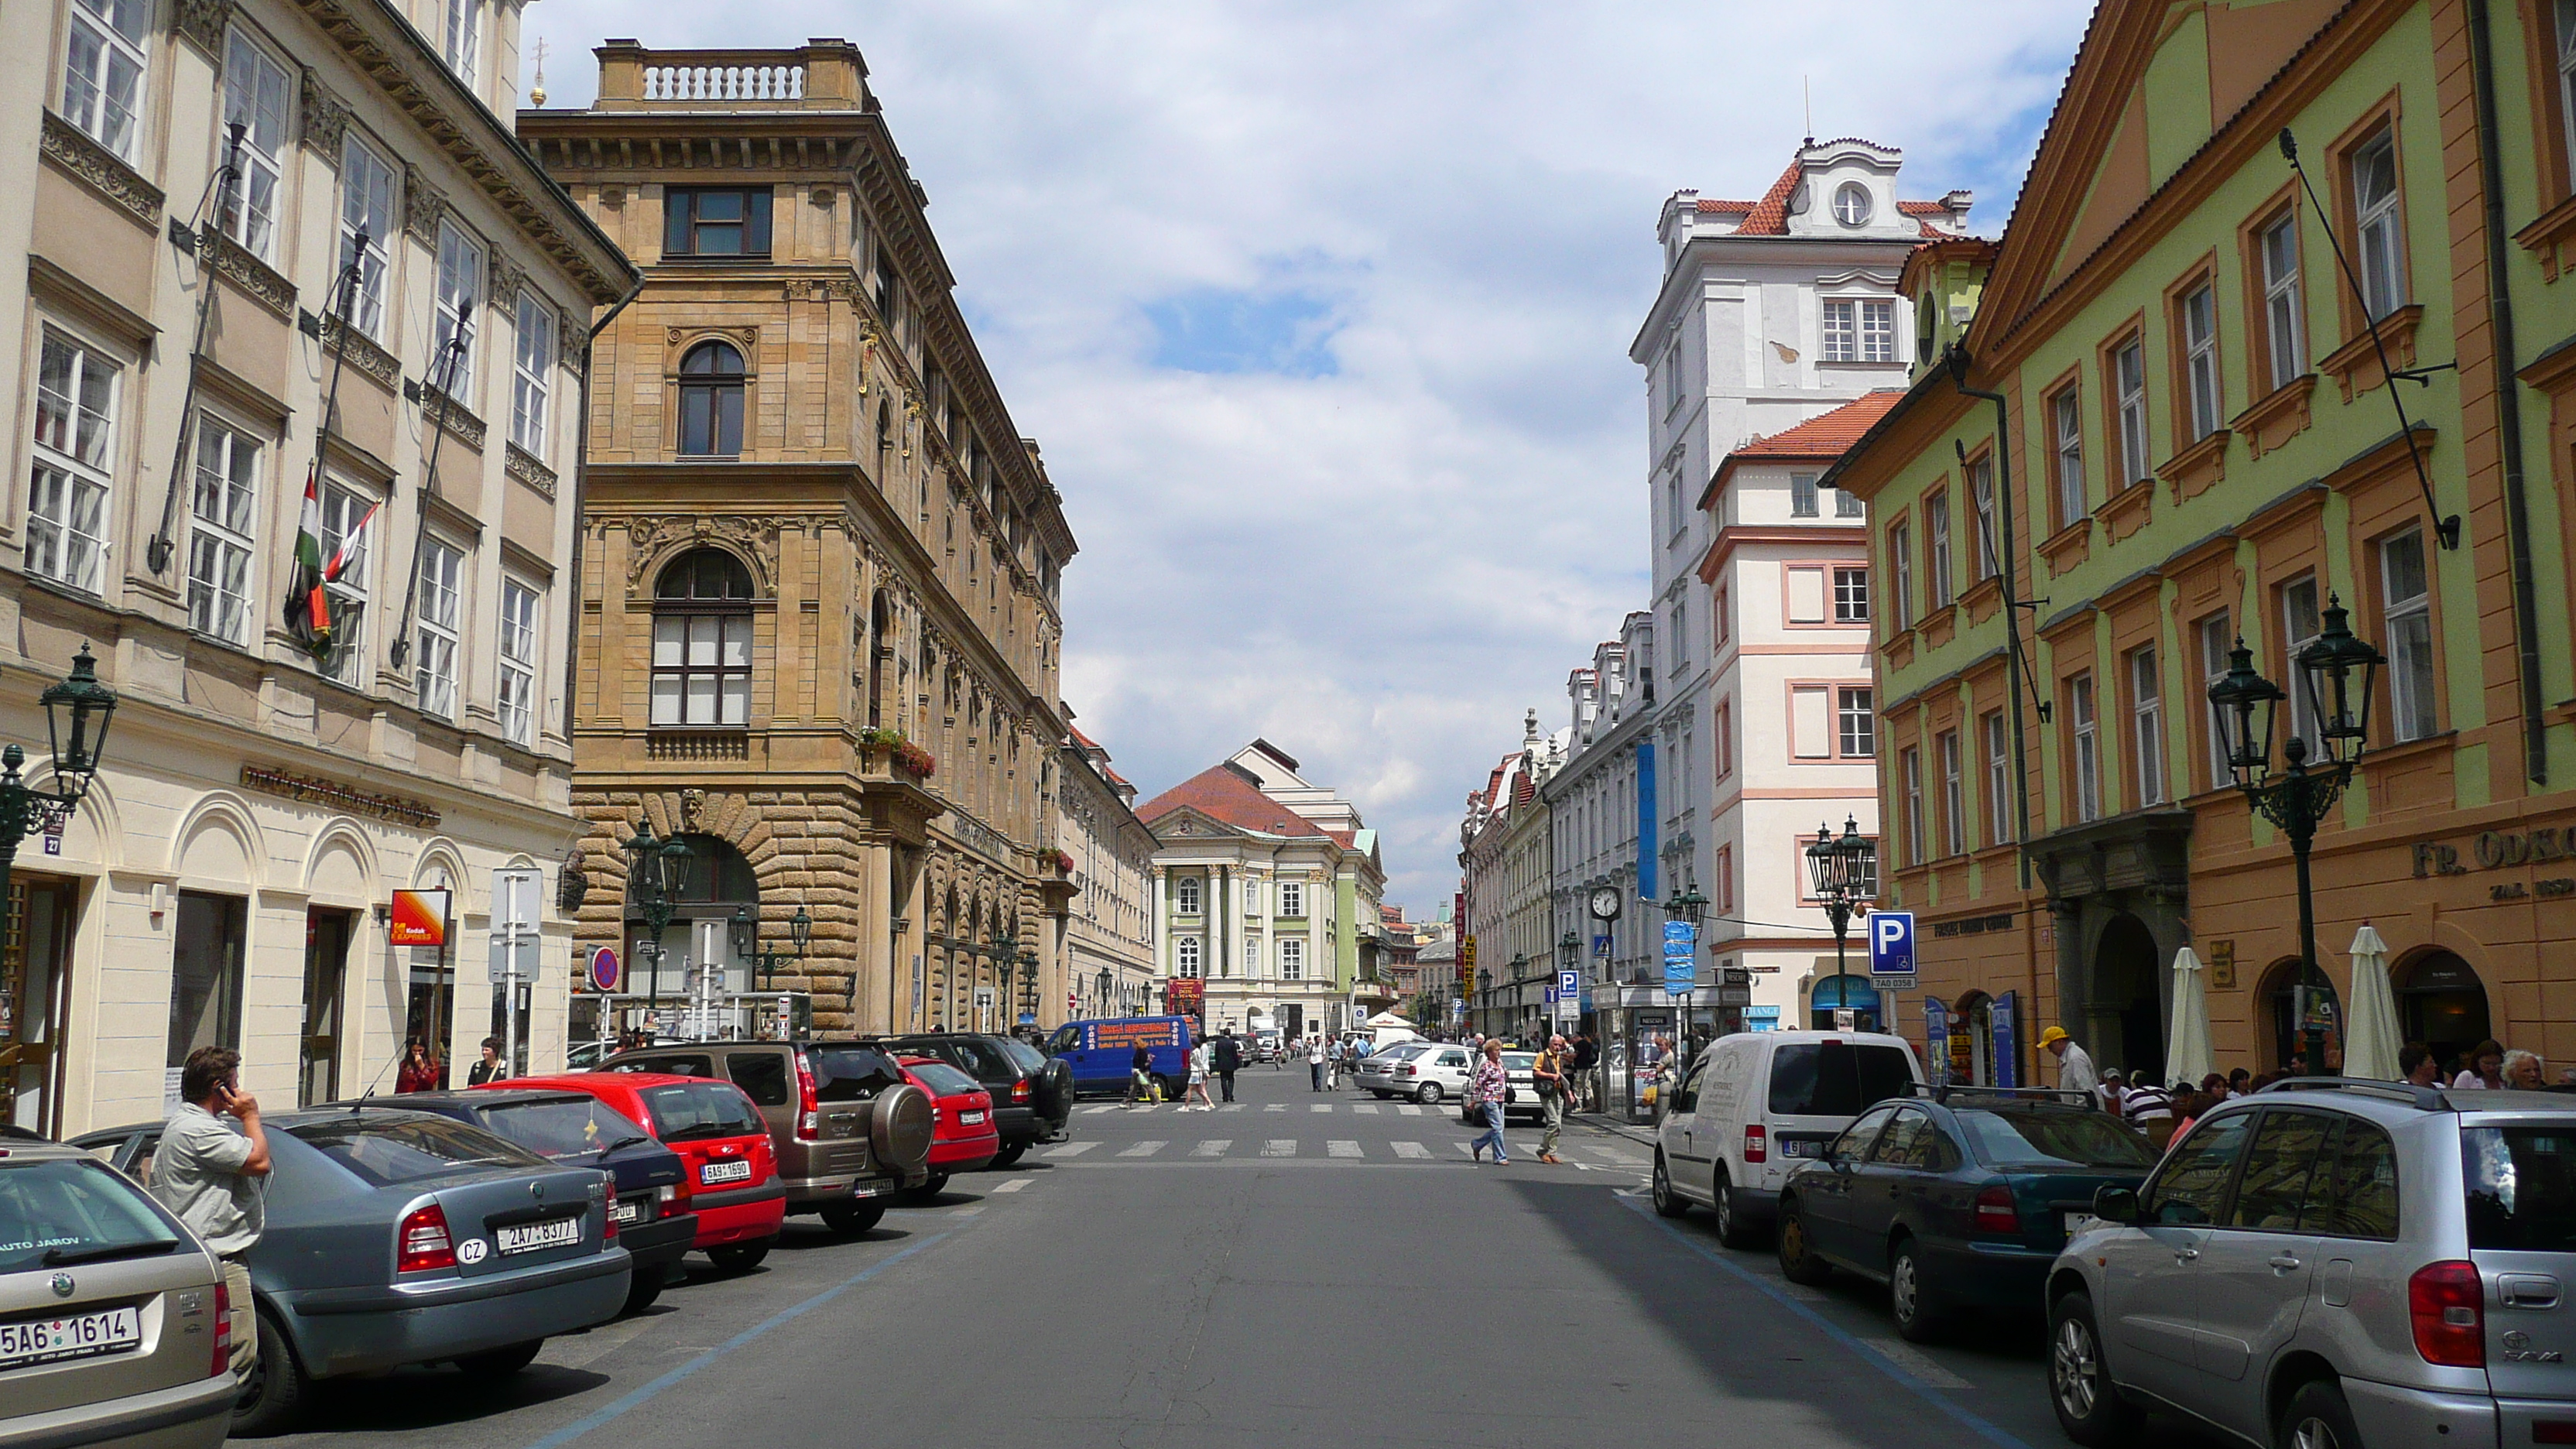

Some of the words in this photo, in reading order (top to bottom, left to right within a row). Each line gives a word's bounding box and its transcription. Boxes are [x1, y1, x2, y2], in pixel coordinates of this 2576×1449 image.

[48, 839, 59, 851] 27
[1878, 920, 1905, 955] P
[1464, 934, 1474, 985] INTERNET
[1562, 974, 1574, 991] P
[1455, 1002, 1462, 1010] P
[707, 1166, 722, 1179] 6A9
[728, 1163, 747, 1175] 1690
[509, 1225, 533, 1245] 2A7
[542, 1219, 570, 1240] 8377
[0, 1241, 33, 1252] AUTO
[36, 1236, 80, 1248] JAROV
[464, 1242, 481, 1260] CZ
[2, 1324, 48, 1354] 5A6
[70, 1312, 127, 1345] 1614
